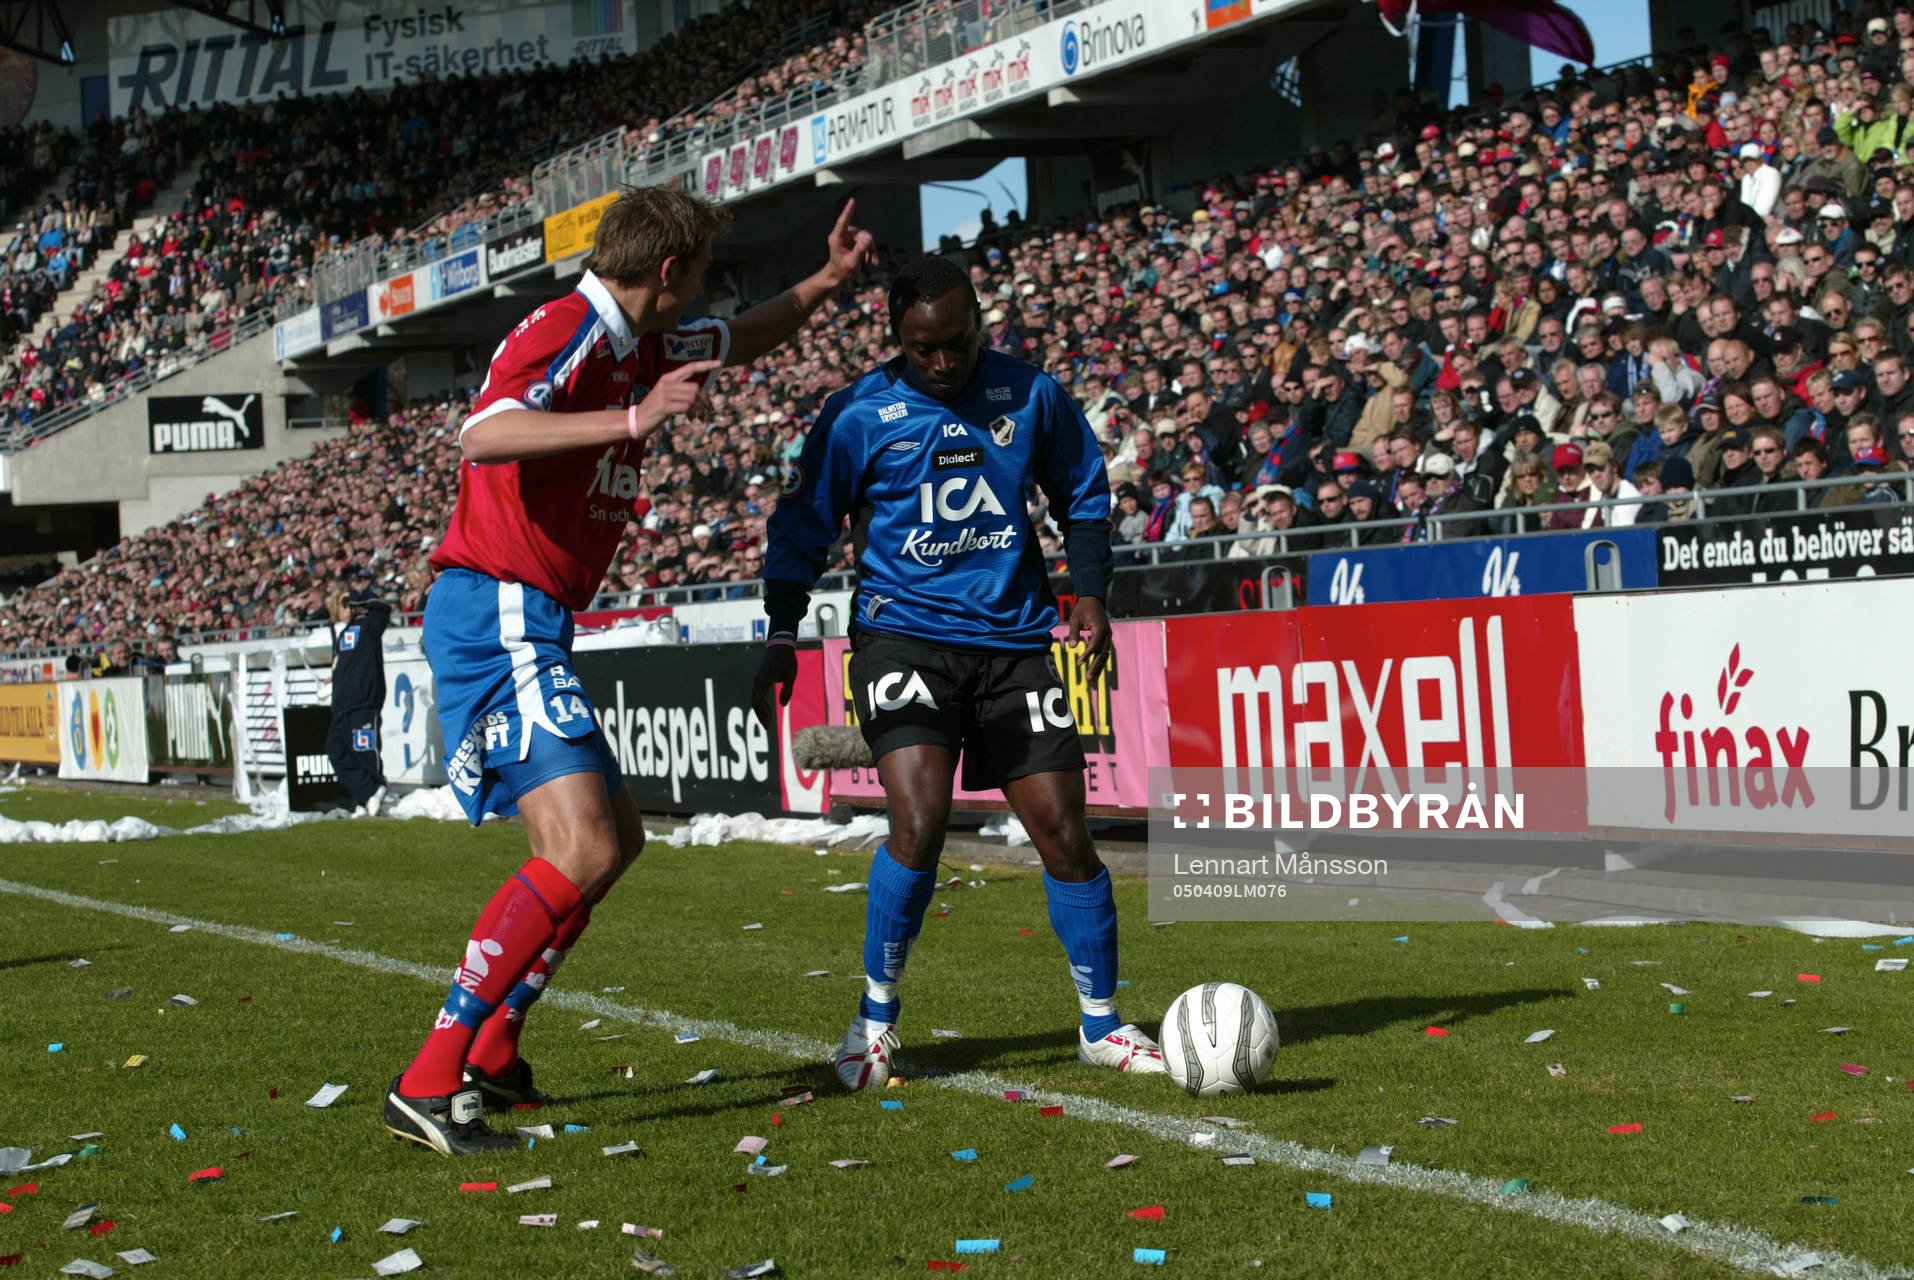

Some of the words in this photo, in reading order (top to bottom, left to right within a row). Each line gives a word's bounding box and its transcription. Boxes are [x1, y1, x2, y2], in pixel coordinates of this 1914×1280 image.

[364, 5, 465, 46] Fysisk
[1080, 14, 1145, 67] Brinova
[118, 21, 348, 114] RITTAL
[365, 34, 550, 82] IT-säkerhet
[828, 97, 896, 155] ARMATUR
[153, 421, 236, 452] PUMA
[942, 423, 968, 438] ICA
[938, 452, 977, 466] Dialect
[920, 475, 1007, 523] ICA
[900, 525, 1017, 567] Kundkort
[1662, 535, 1699, 571] Det
[1703, 531, 1755, 569] enda
[1760, 528, 1788, 564] du
[1792, 521, 1884, 562] behöver
[1888, 516, 1914, 555] sä
[550, 694, 590, 724] 14
[867, 670, 939, 721] ICA
[1217, 615, 1515, 808] maxell
[594, 678, 769, 804] skaspel.se
[1655, 690, 1815, 824] finax
